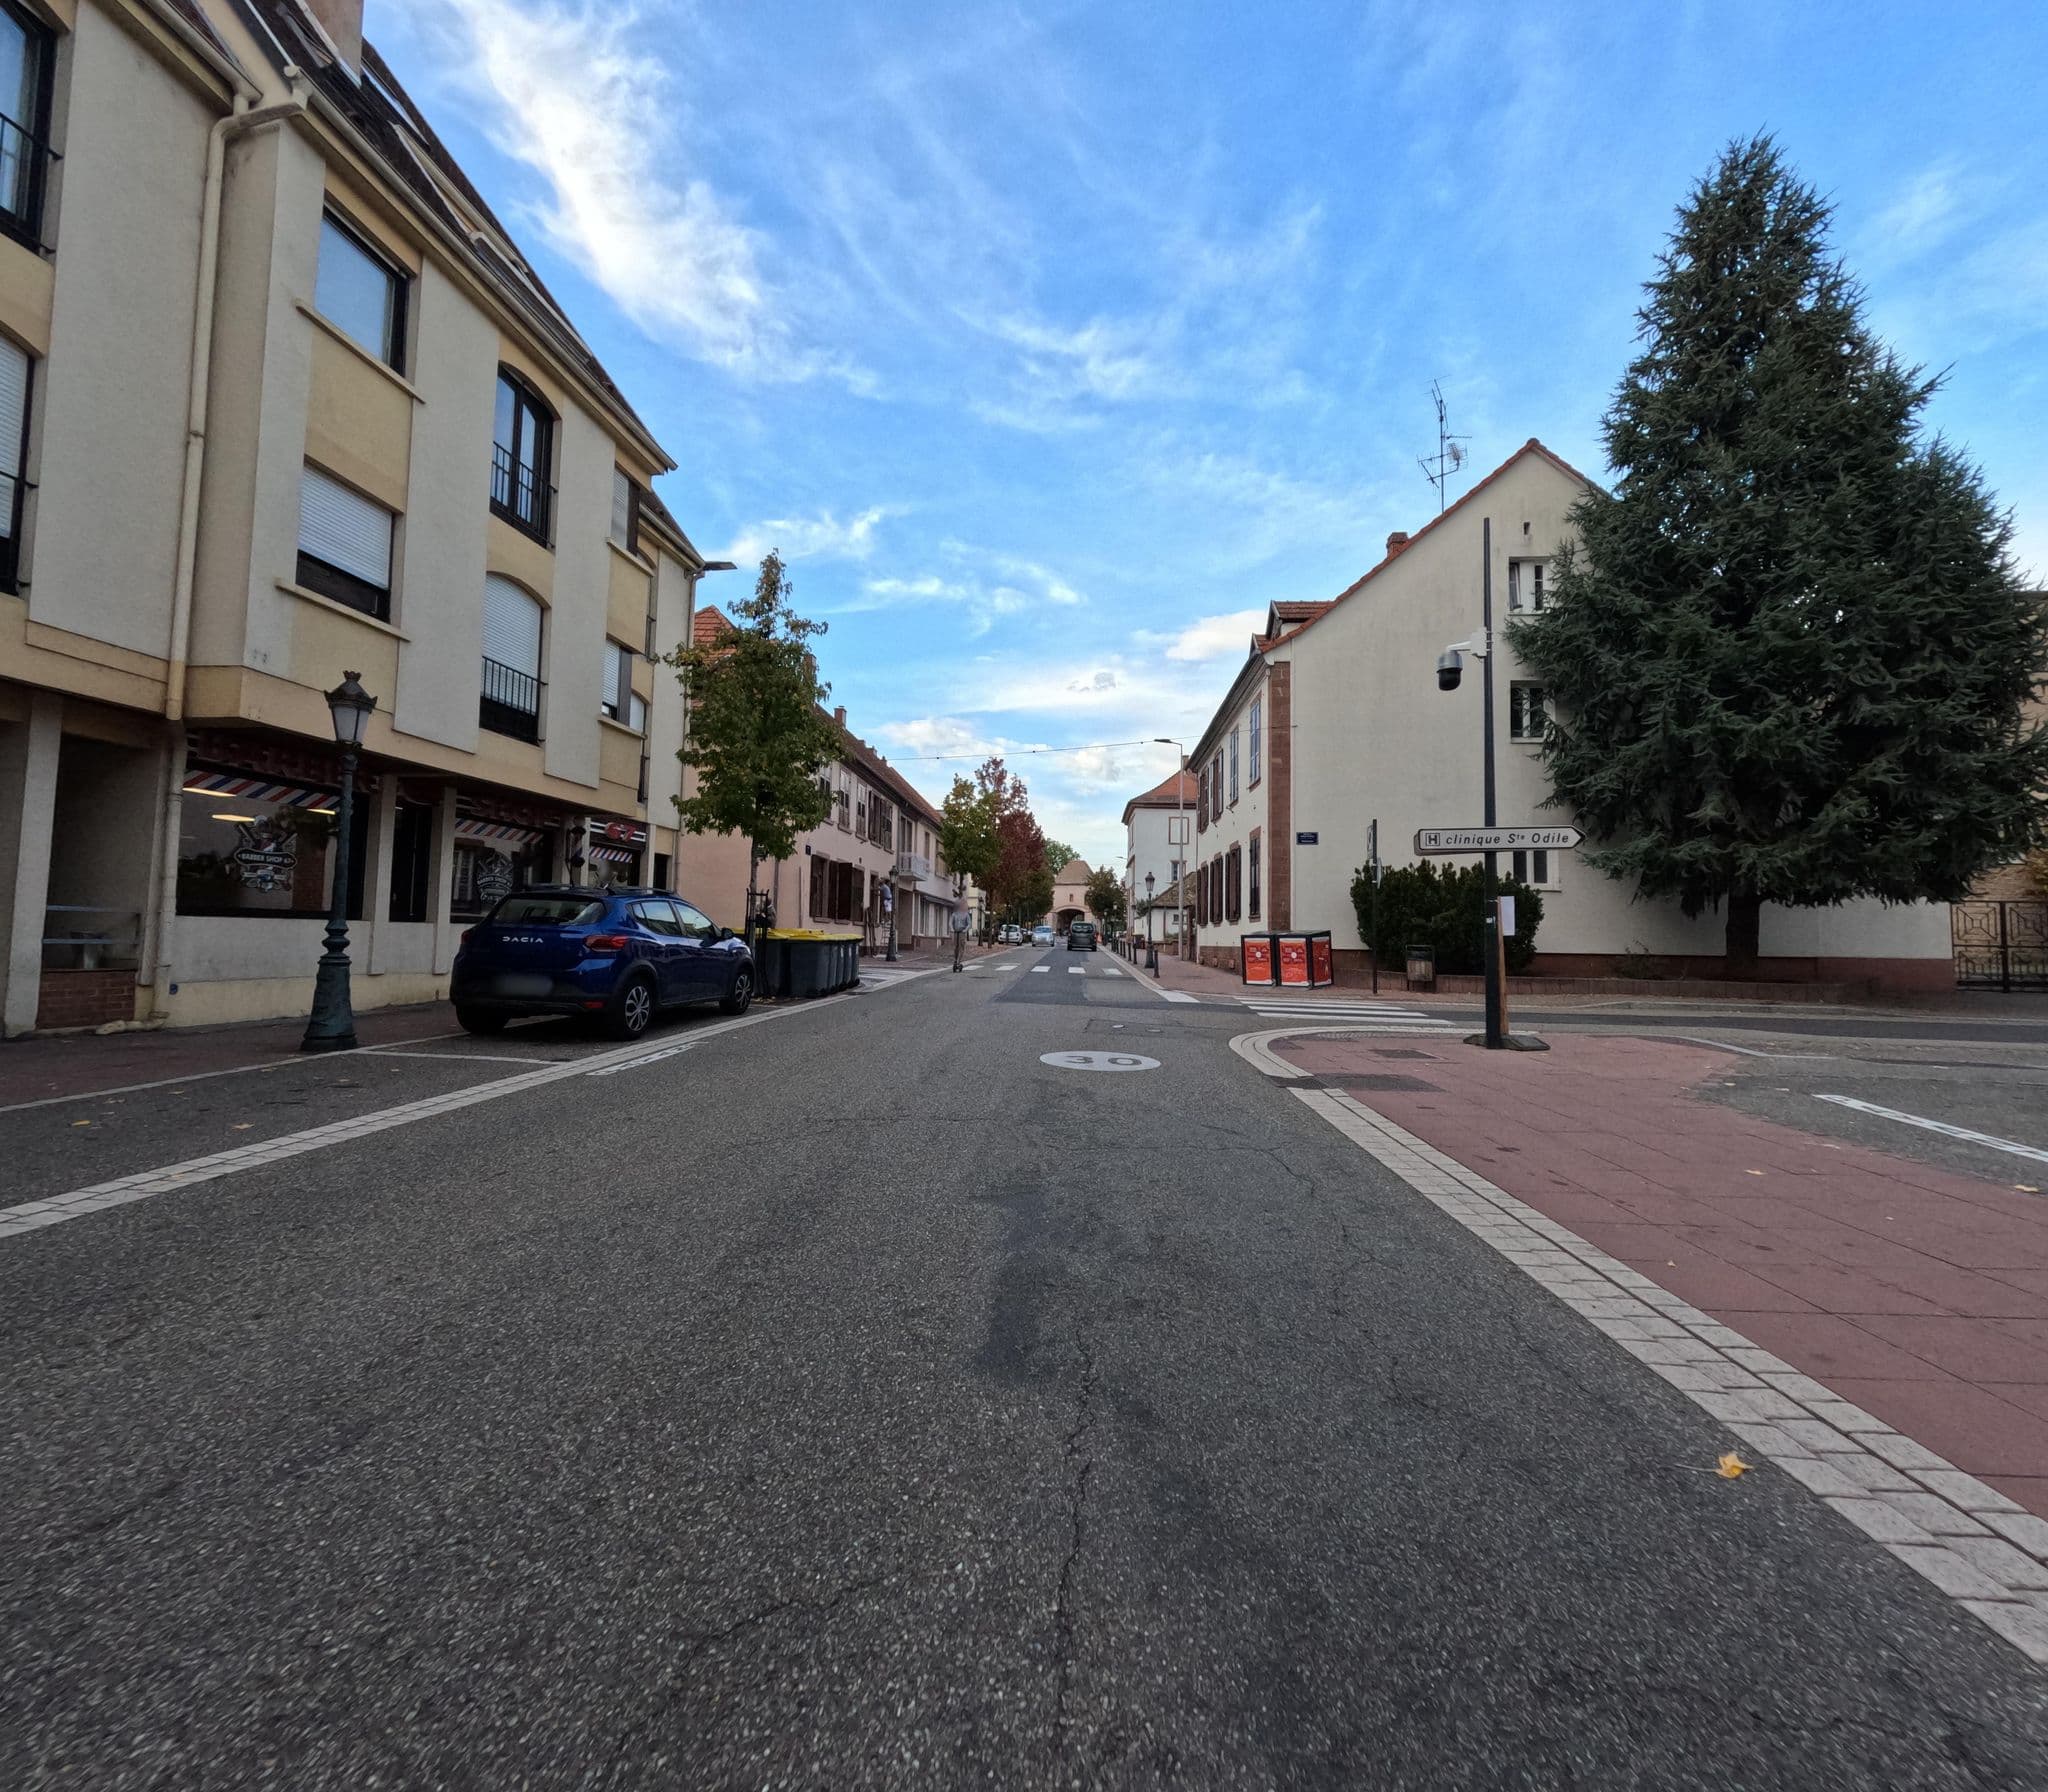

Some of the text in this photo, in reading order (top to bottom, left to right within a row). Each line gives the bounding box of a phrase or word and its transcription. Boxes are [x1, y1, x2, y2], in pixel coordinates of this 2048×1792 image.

[605, 822, 637, 841] 67
[1446, 834, 1501, 847] clinique
[1507, 833, 1525, 844] Ste
[1531, 832, 1569, 844] Odile
[1064, 1055, 1142, 1066] 30
